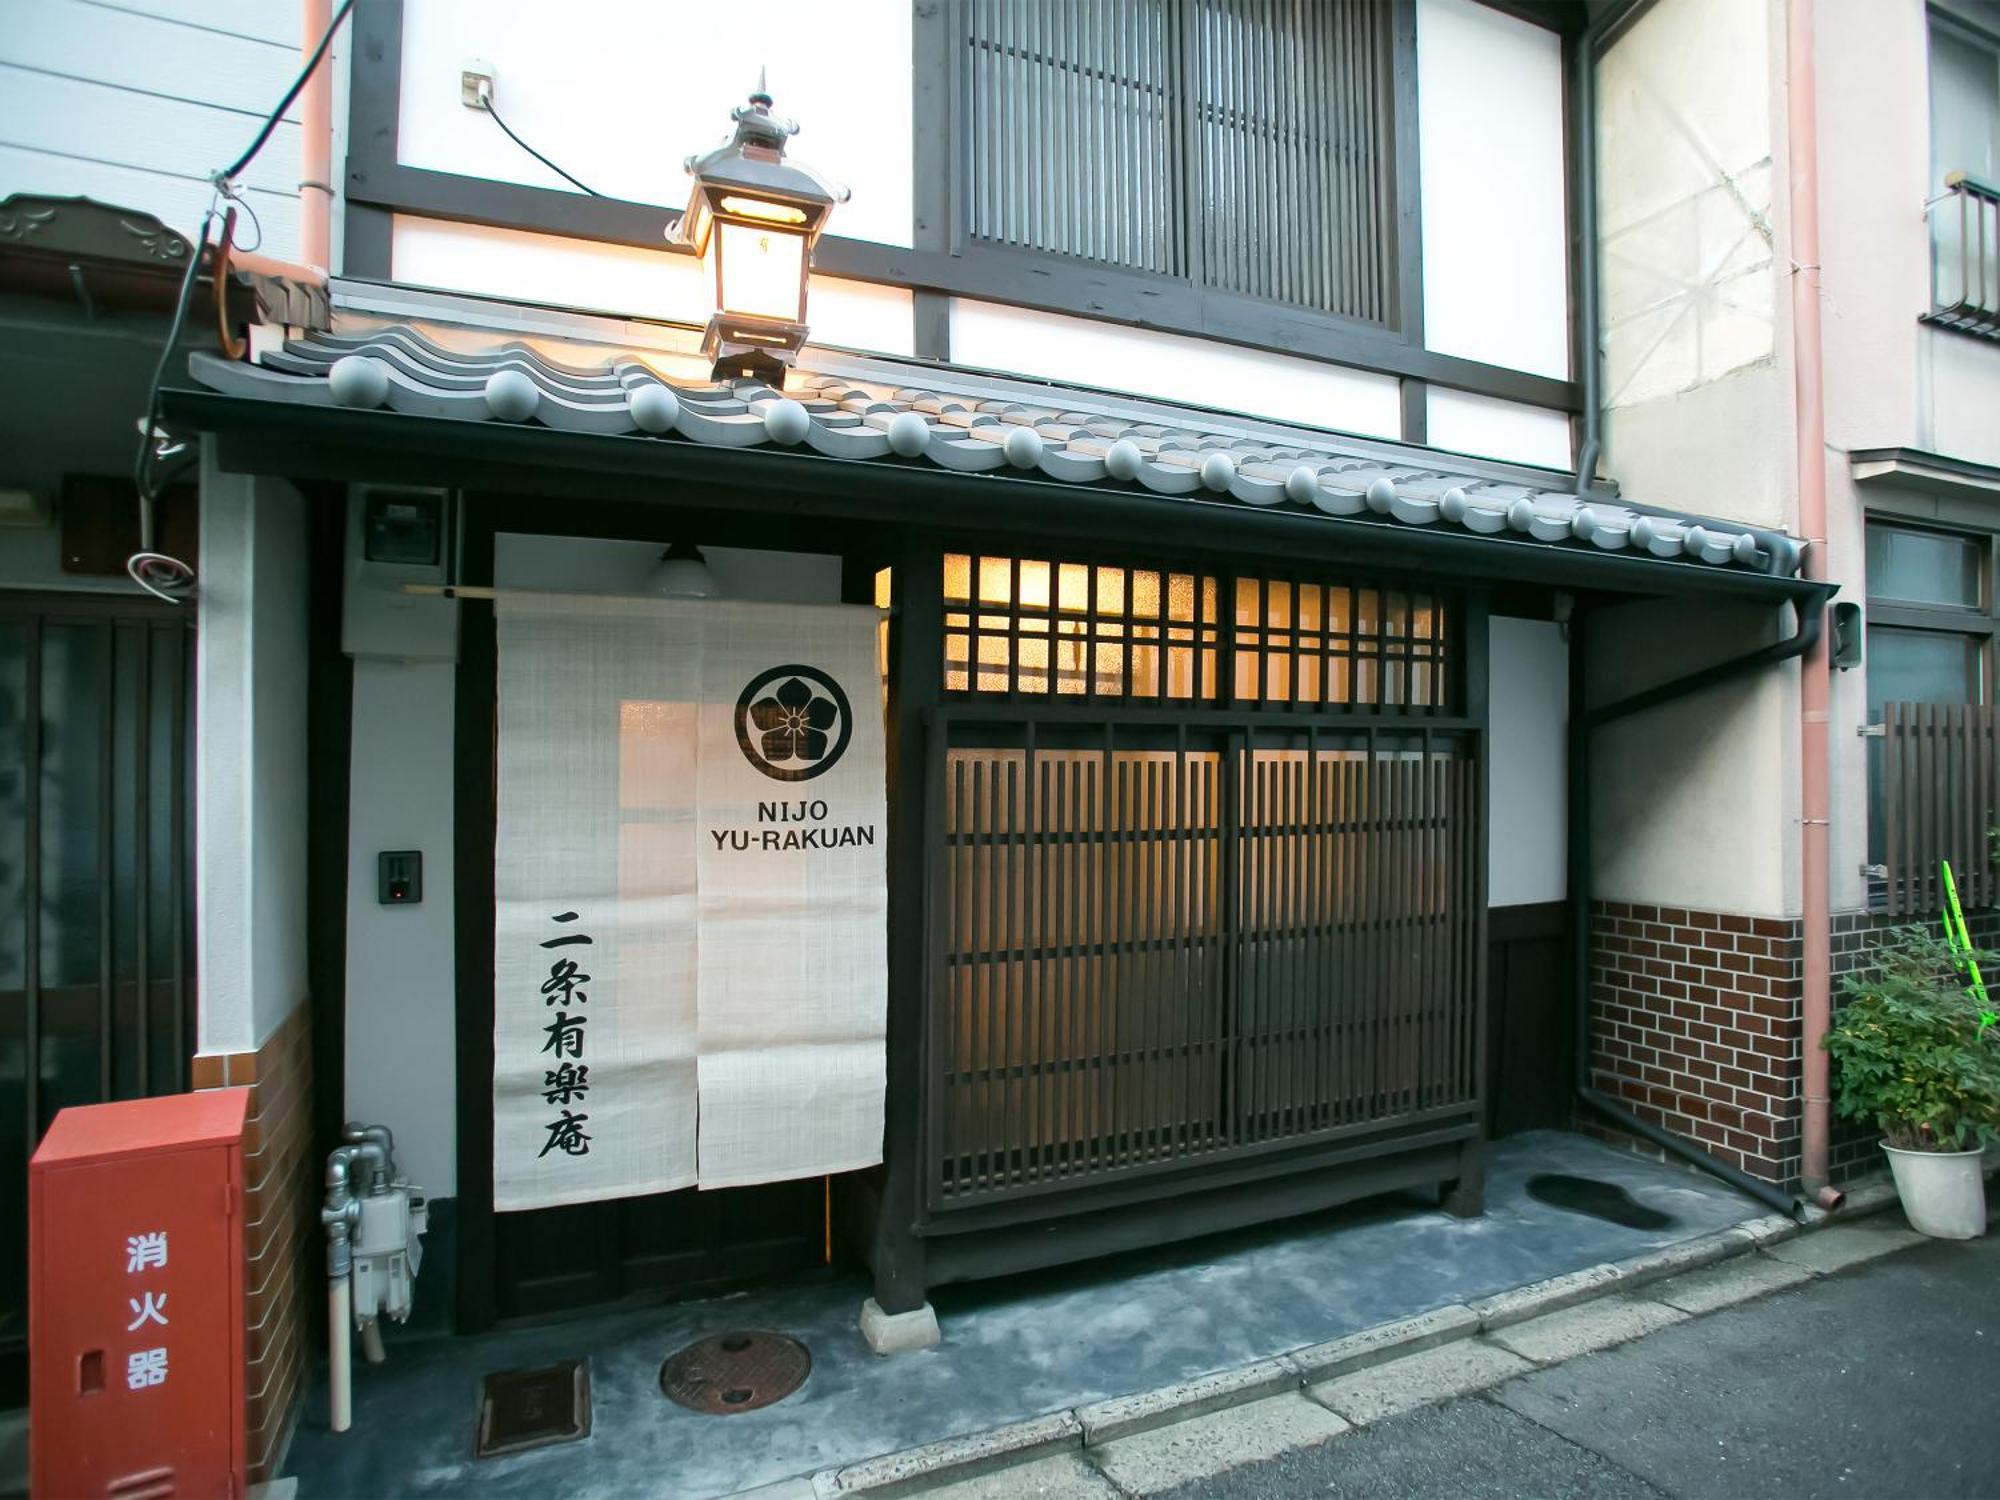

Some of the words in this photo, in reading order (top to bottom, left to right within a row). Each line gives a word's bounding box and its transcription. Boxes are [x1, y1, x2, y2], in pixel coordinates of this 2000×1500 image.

[712, 826, 874, 851] YU-RAKUAN
[759, 800, 828, 822] NIJO
[538, 911, 593, 1158] 二条有楽庵
[126, 1231, 169, 1390] 消火器
